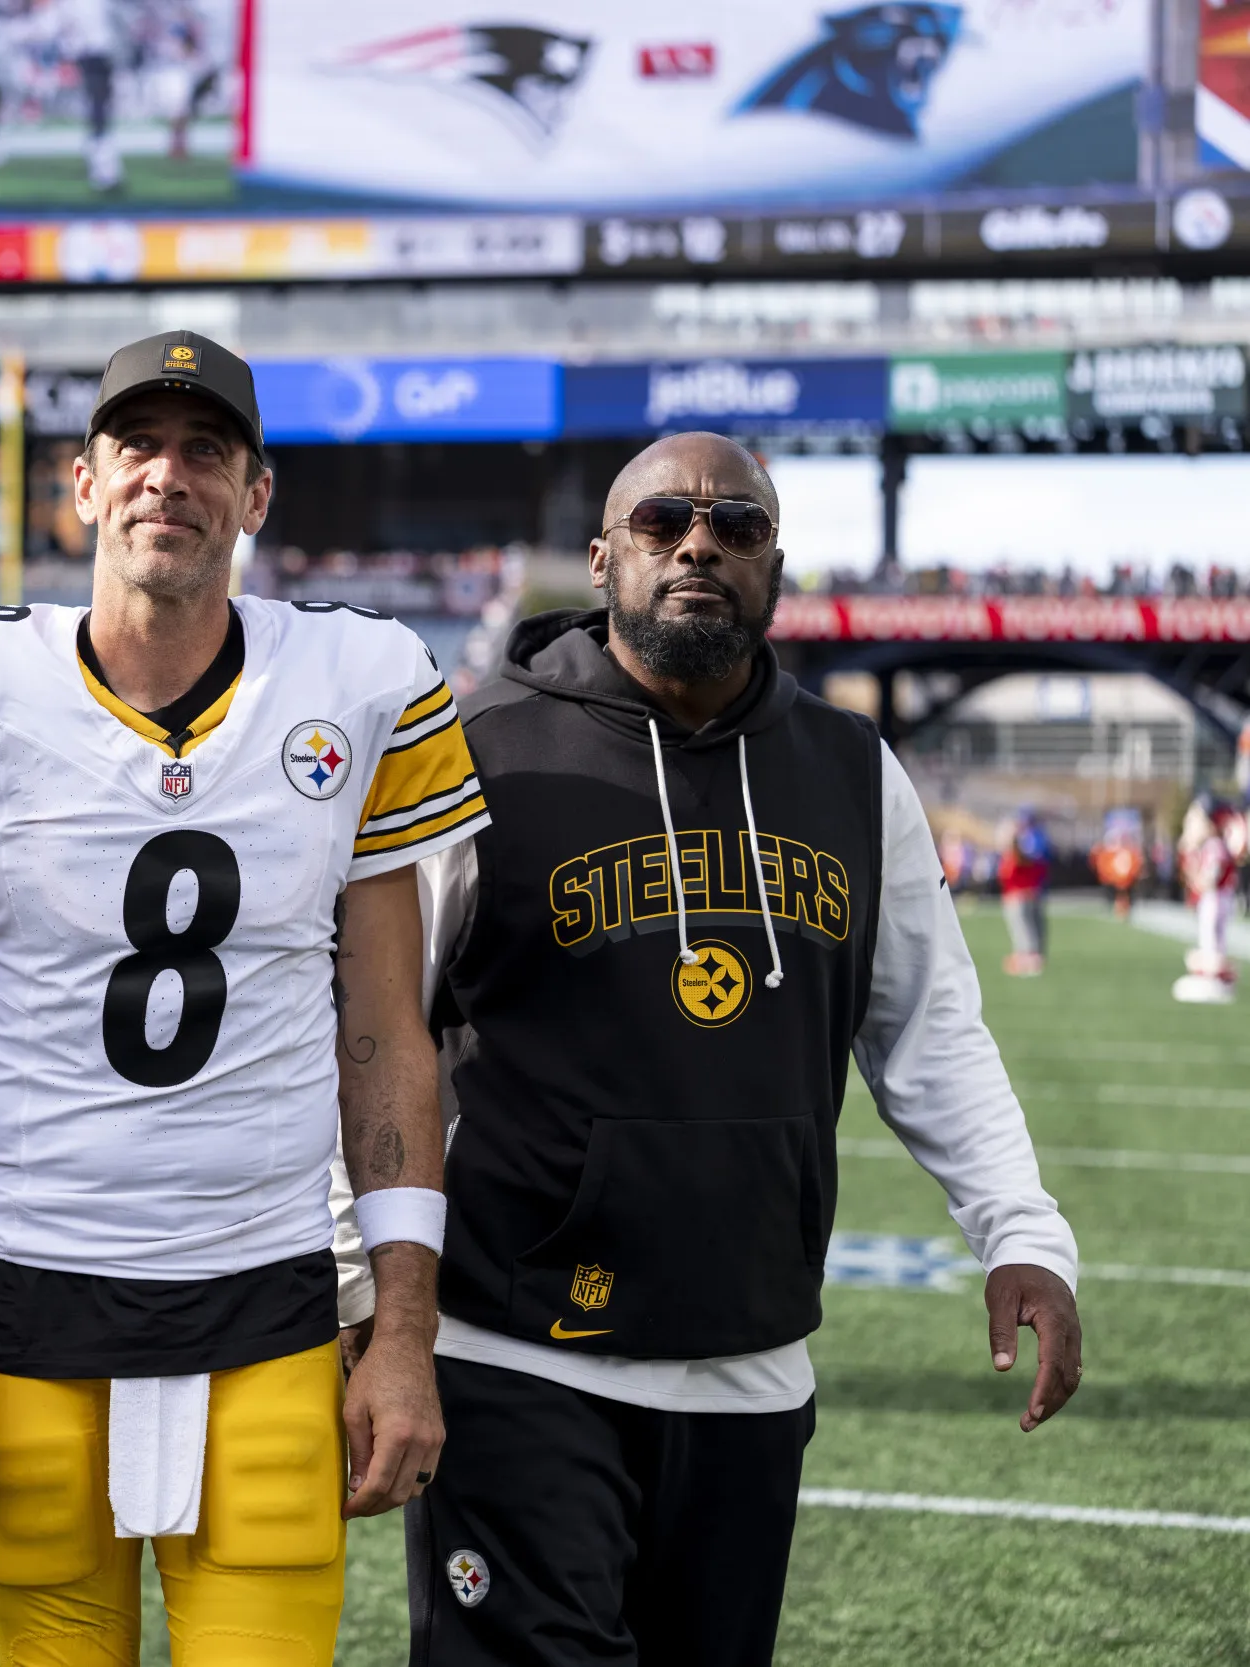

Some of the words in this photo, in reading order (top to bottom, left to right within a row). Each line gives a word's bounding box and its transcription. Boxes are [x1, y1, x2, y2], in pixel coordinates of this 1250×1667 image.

[980, 205, 1108, 251] Gillette
[647, 363, 798, 423] jetBlue
[290, 753, 318, 763] Steelers
[165, 777, 188, 794] NFL
[550, 830, 849, 948] STEELERS
[102, 830, 241, 1087] 8
[682, 978, 708, 987] Steelers
[575, 1281, 605, 1305] NFL
